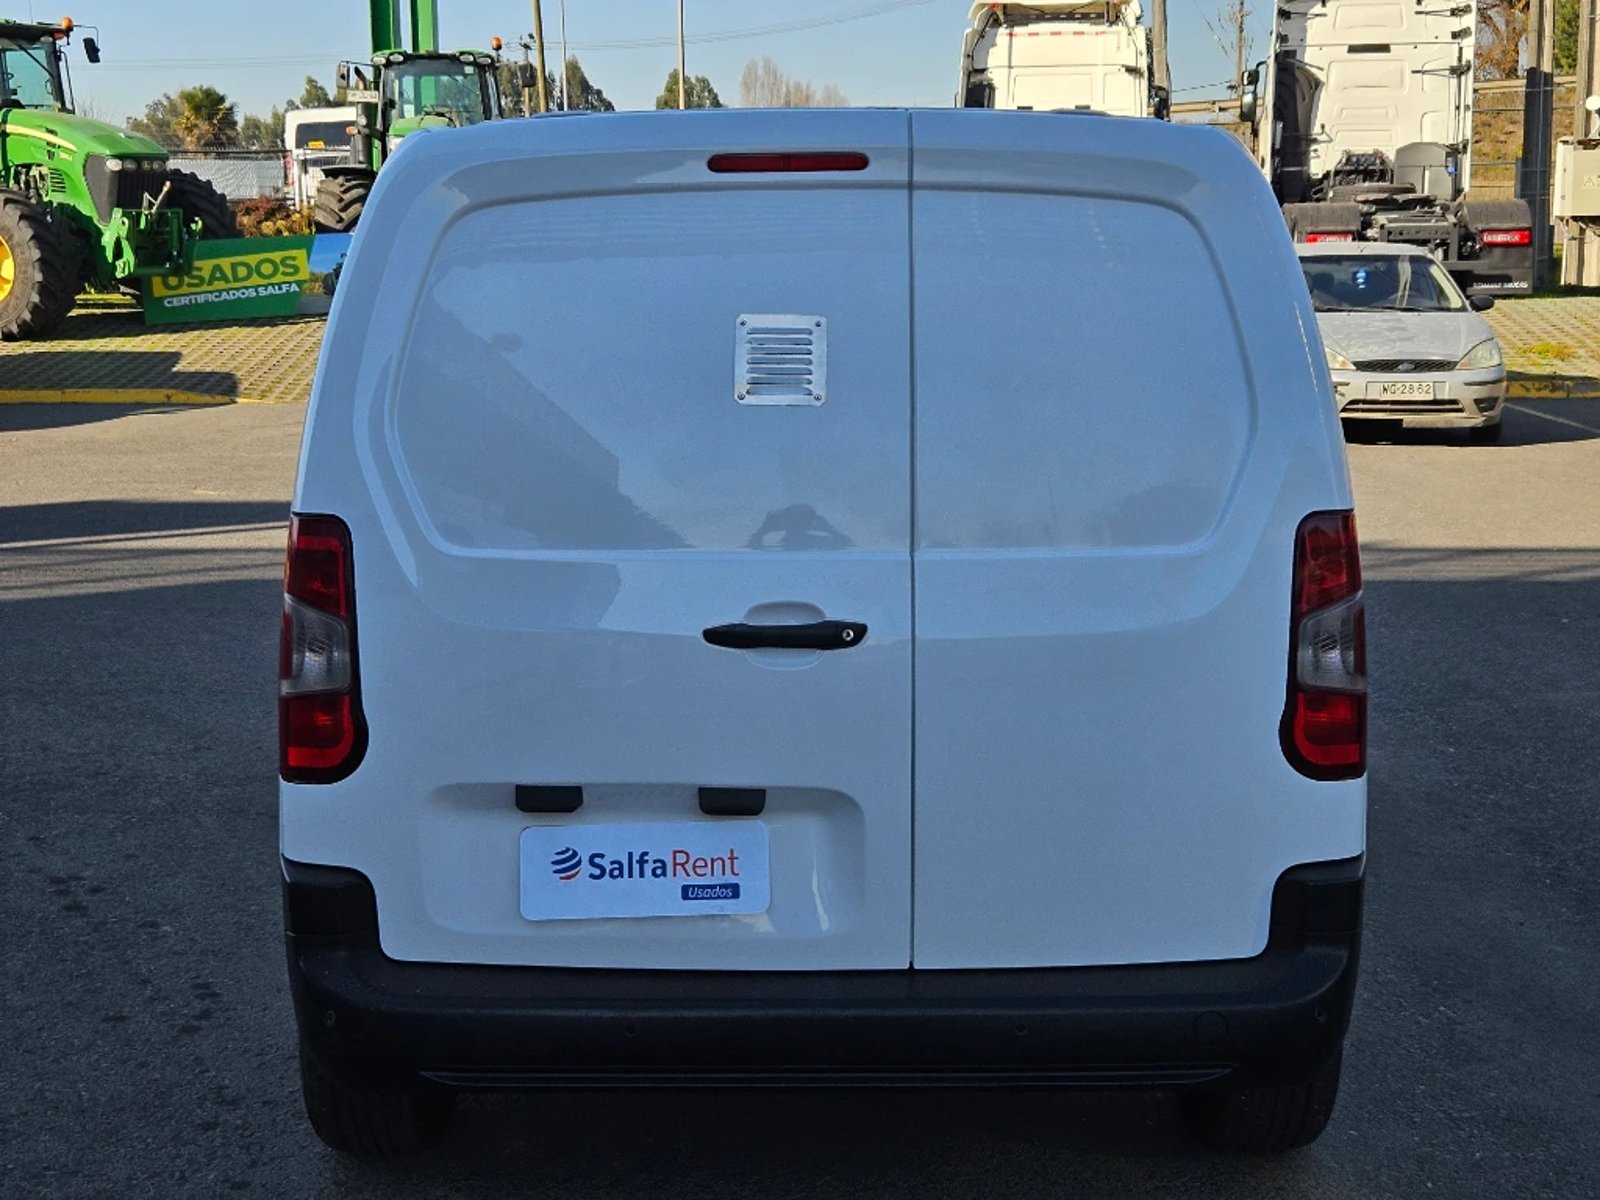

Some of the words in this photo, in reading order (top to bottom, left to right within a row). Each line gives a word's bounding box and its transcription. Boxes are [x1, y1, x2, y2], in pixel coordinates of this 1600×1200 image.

[161, 255, 301, 291] USADOS
[163, 288, 257, 308] CERTIFICADOS
[257, 282, 300, 297] SALFA
[587, 848, 740, 881] SalfaRent
[688, 885, 733, 899] Usados
